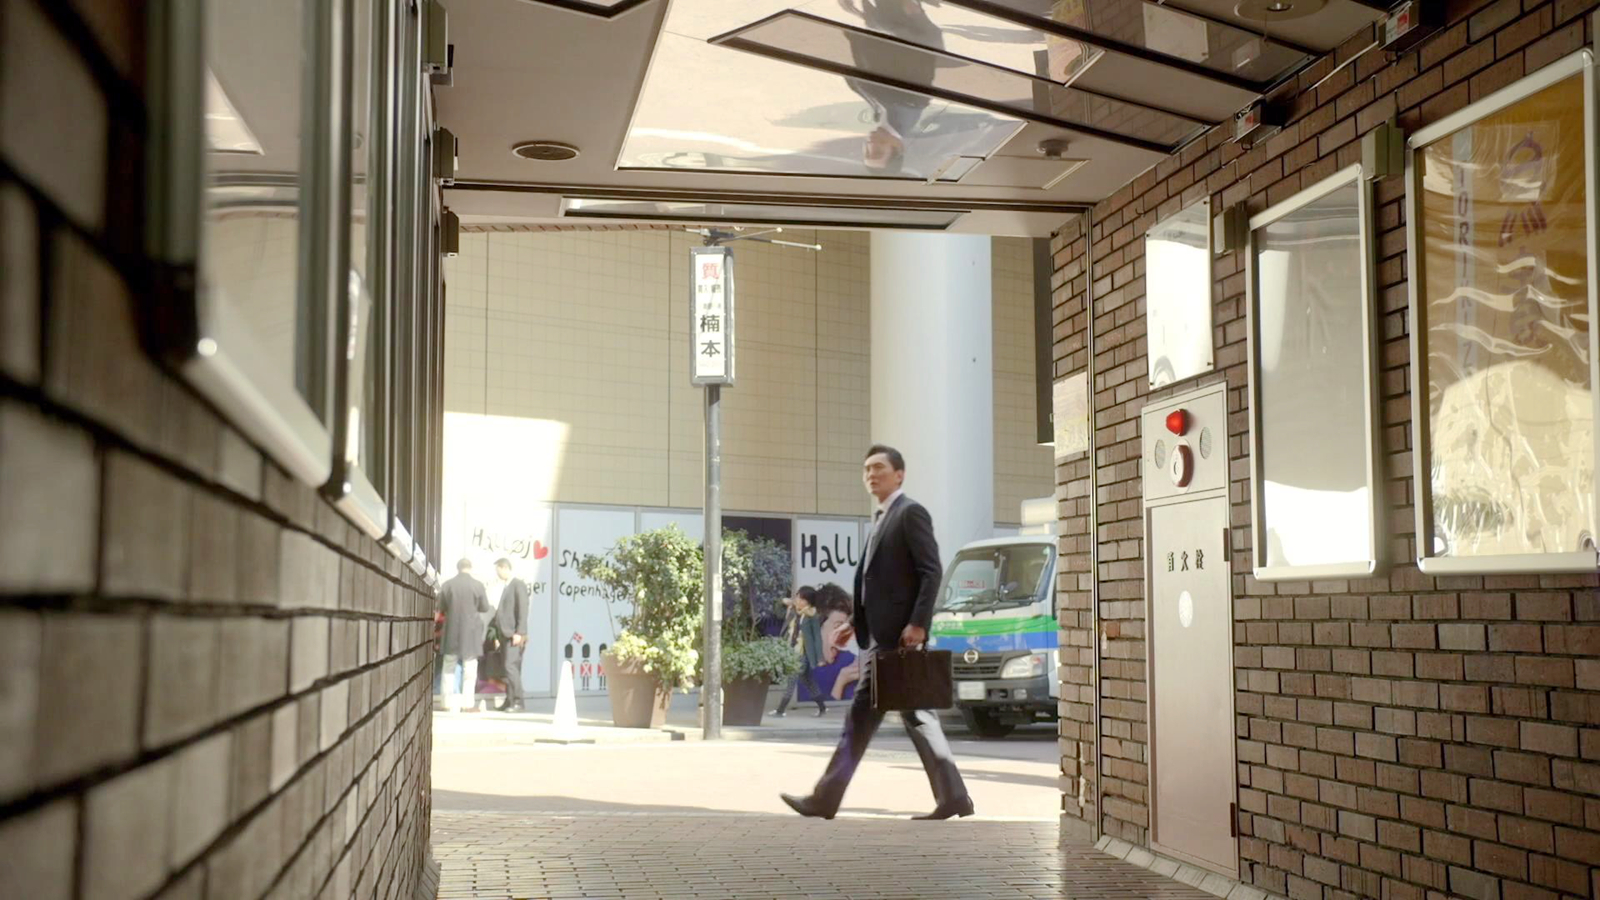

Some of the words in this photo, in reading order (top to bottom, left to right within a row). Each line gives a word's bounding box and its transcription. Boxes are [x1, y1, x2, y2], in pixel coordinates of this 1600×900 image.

[702, 262, 719, 279] 質
[700, 314, 721, 358] 楠本
[801, 533, 858, 574] Hall
